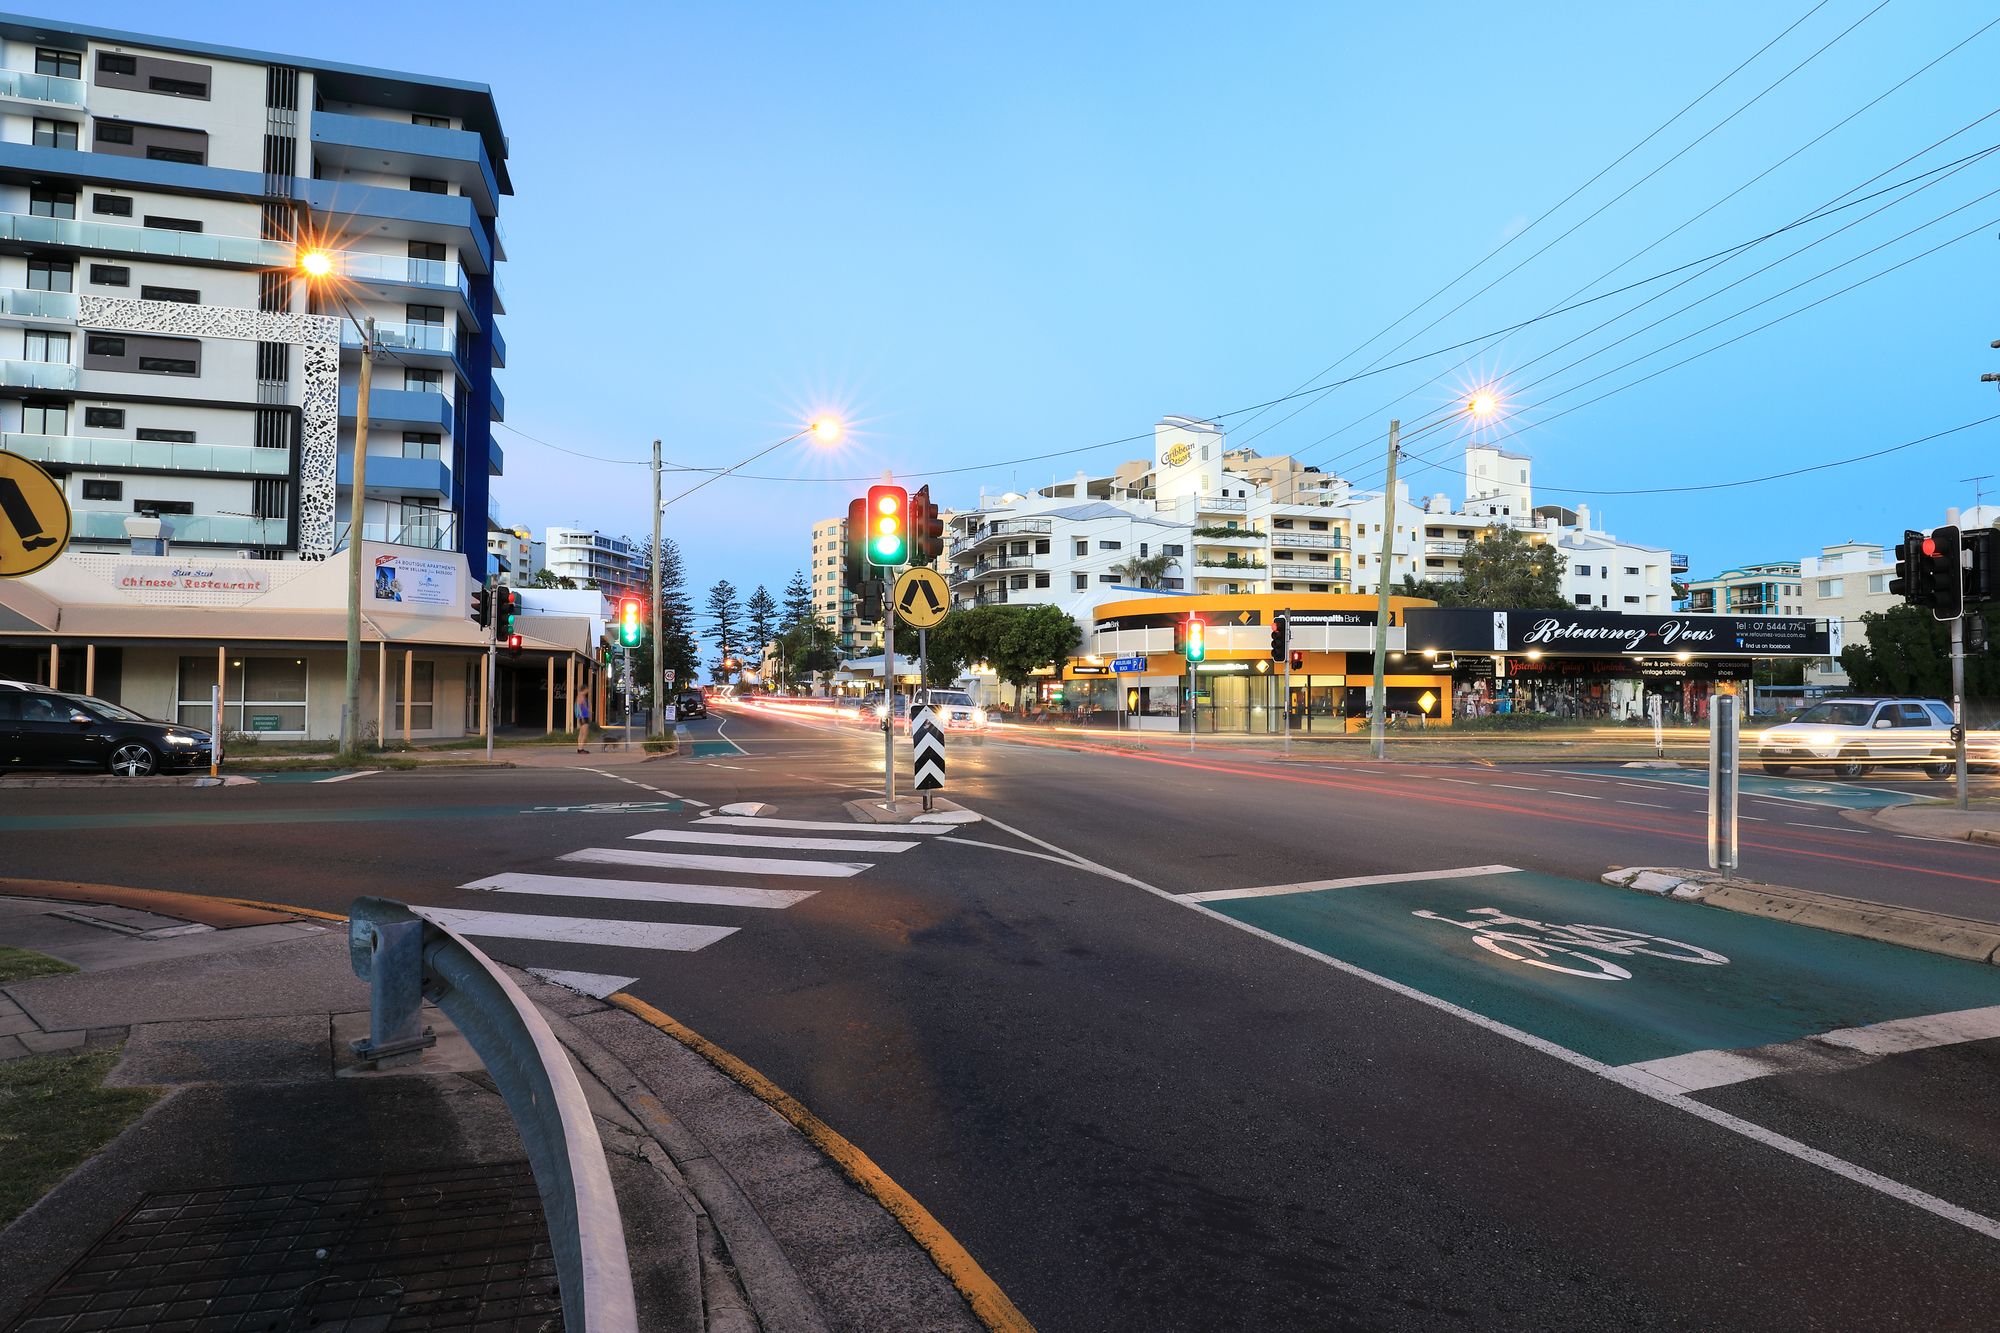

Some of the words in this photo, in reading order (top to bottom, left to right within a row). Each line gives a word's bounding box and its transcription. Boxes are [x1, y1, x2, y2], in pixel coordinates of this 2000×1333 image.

[1161, 443, 1195, 465] Caribbean
[1168, 452, 1191, 468] Resort
[427, 563, 456, 571] APARTMENTS
[122, 576, 173, 588] Chinese
[184, 578, 261, 590] Restaurant
[1753, 622, 1764, 630] 07
[1766, 622, 1787, 630] 5444
